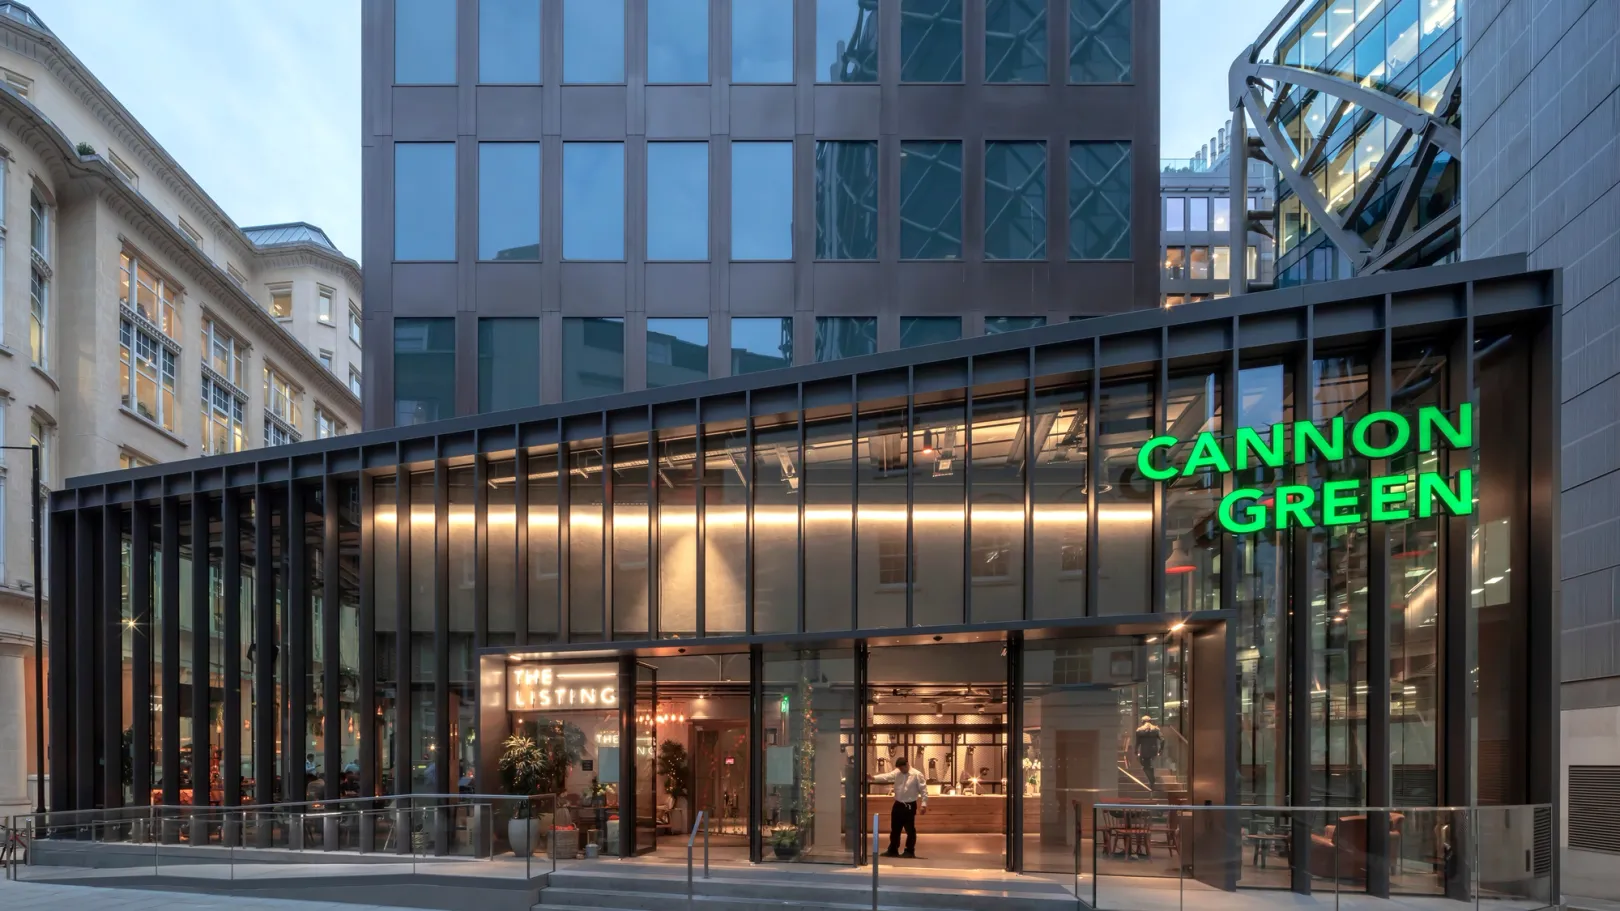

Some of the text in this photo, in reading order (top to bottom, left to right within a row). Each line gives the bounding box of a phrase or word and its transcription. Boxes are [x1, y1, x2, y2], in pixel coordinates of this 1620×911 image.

[1137, 402, 1472, 480] CANNON
[1218, 469, 1473, 533] GREEN
[514, 668, 552, 686] THE
[514, 687, 617, 707] LISTING
